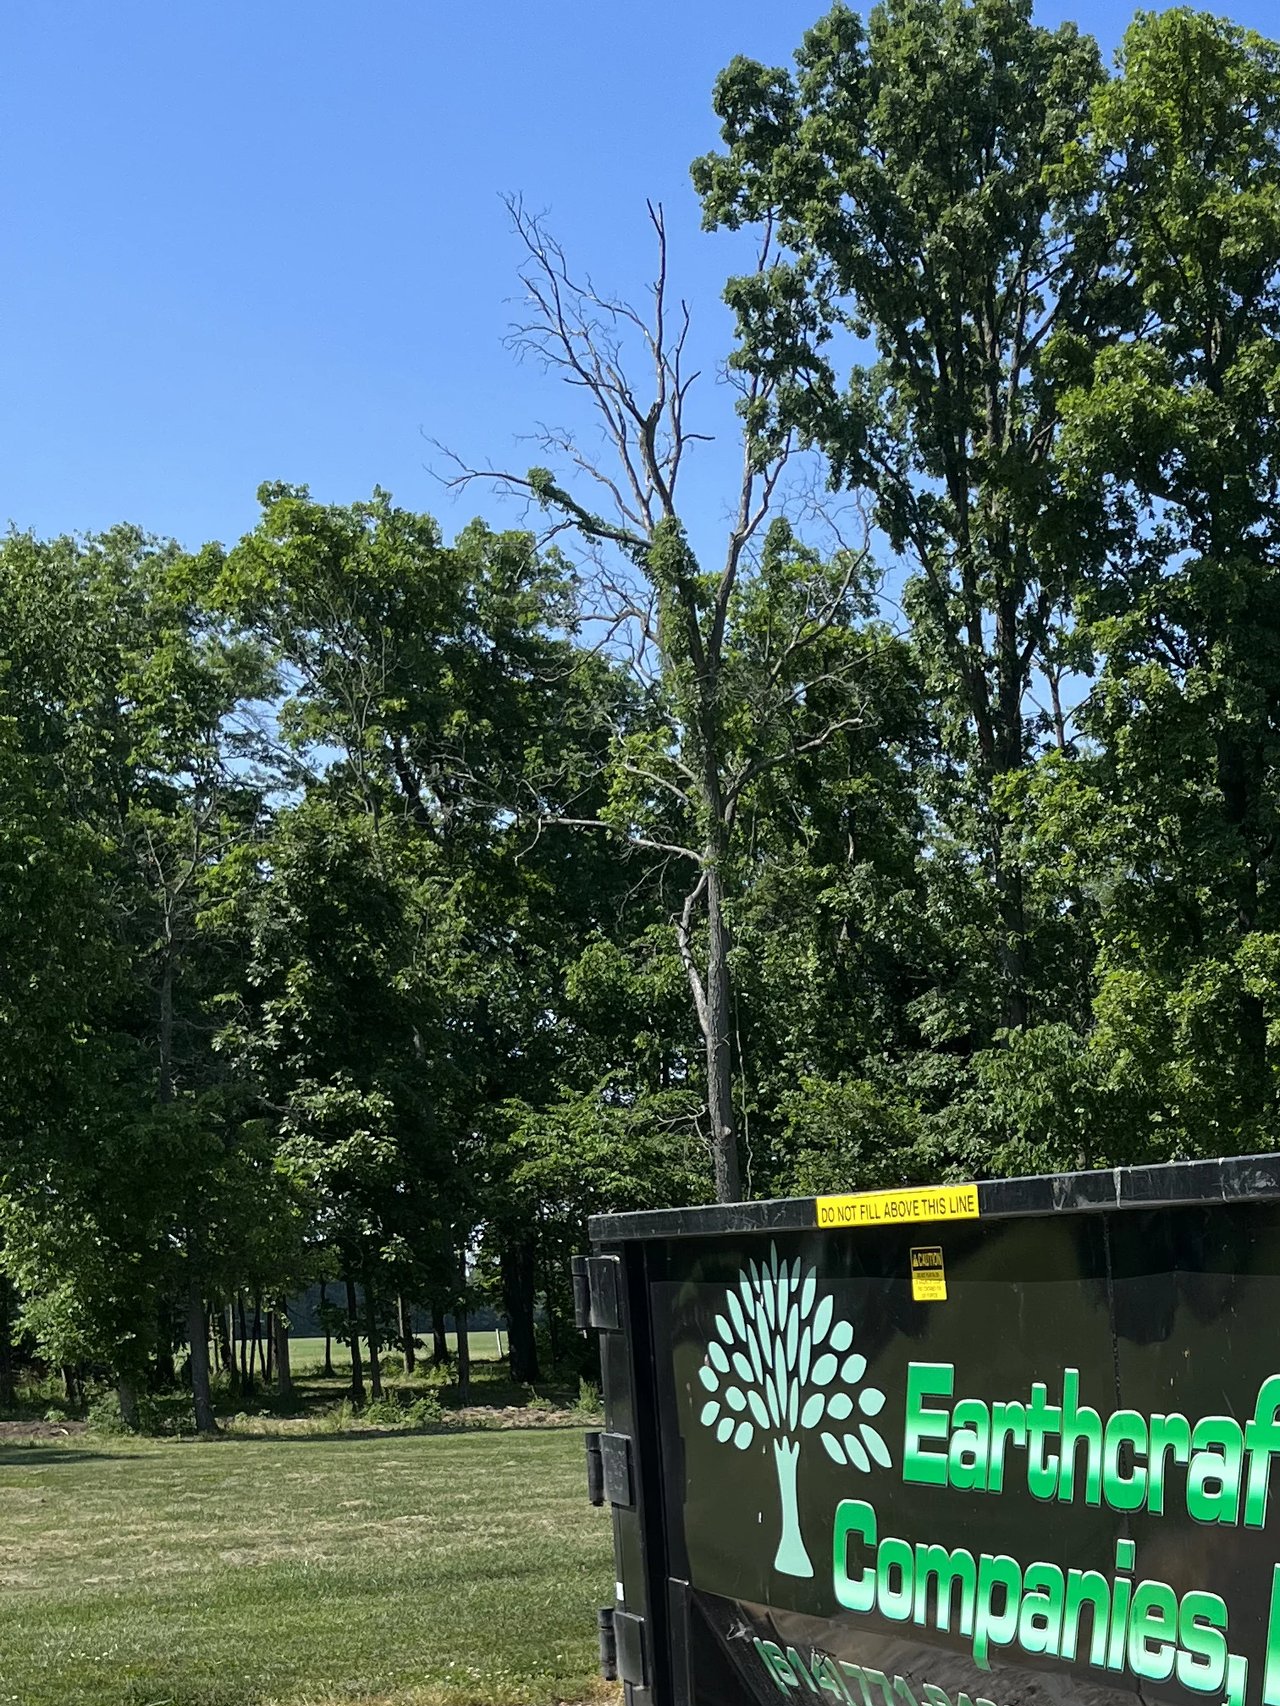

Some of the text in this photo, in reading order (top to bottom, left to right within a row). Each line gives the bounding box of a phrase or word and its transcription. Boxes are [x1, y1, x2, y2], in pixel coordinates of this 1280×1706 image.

[822, 1195, 974, 1223] DO NOT FILL ABOVE THIS LINE
